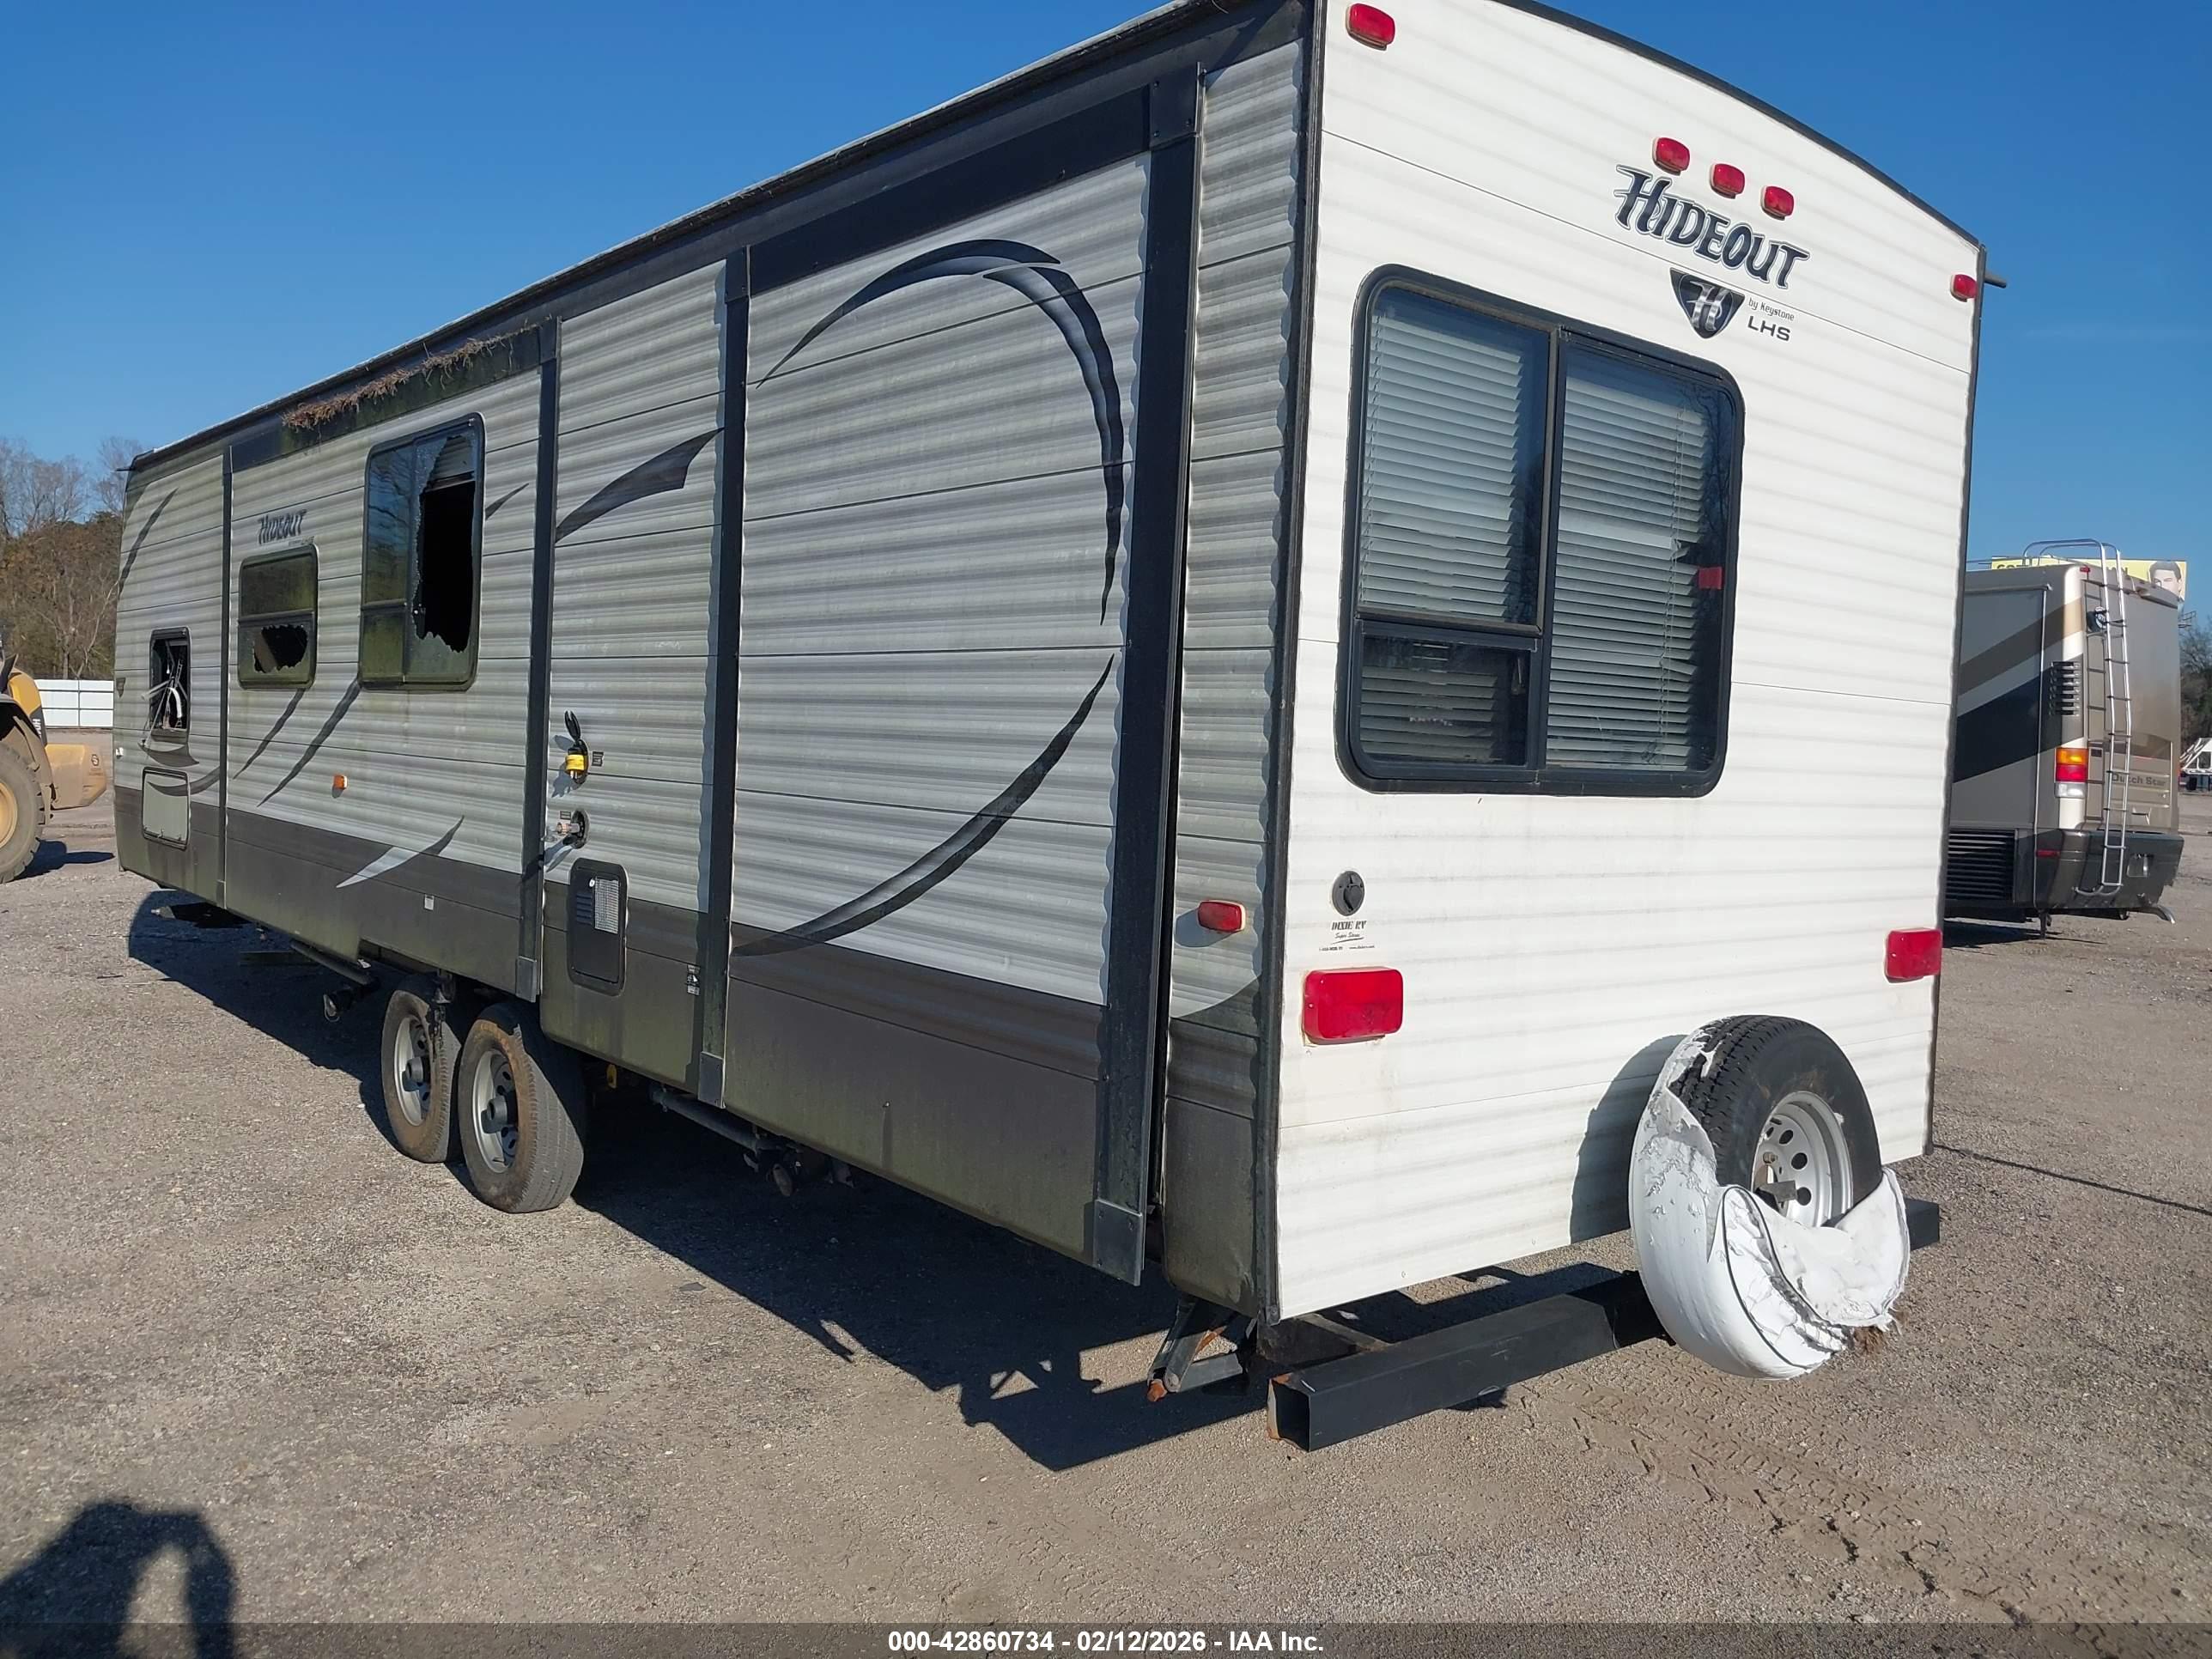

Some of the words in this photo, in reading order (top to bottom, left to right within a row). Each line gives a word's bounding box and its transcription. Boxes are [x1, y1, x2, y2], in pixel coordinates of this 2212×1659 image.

[1614, 164, 1810, 289] HIDEOUT
[1748, 298, 1759, 311] by
[1760, 301, 1795, 321] Keystone
[1747, 316, 1791, 341] LHS
